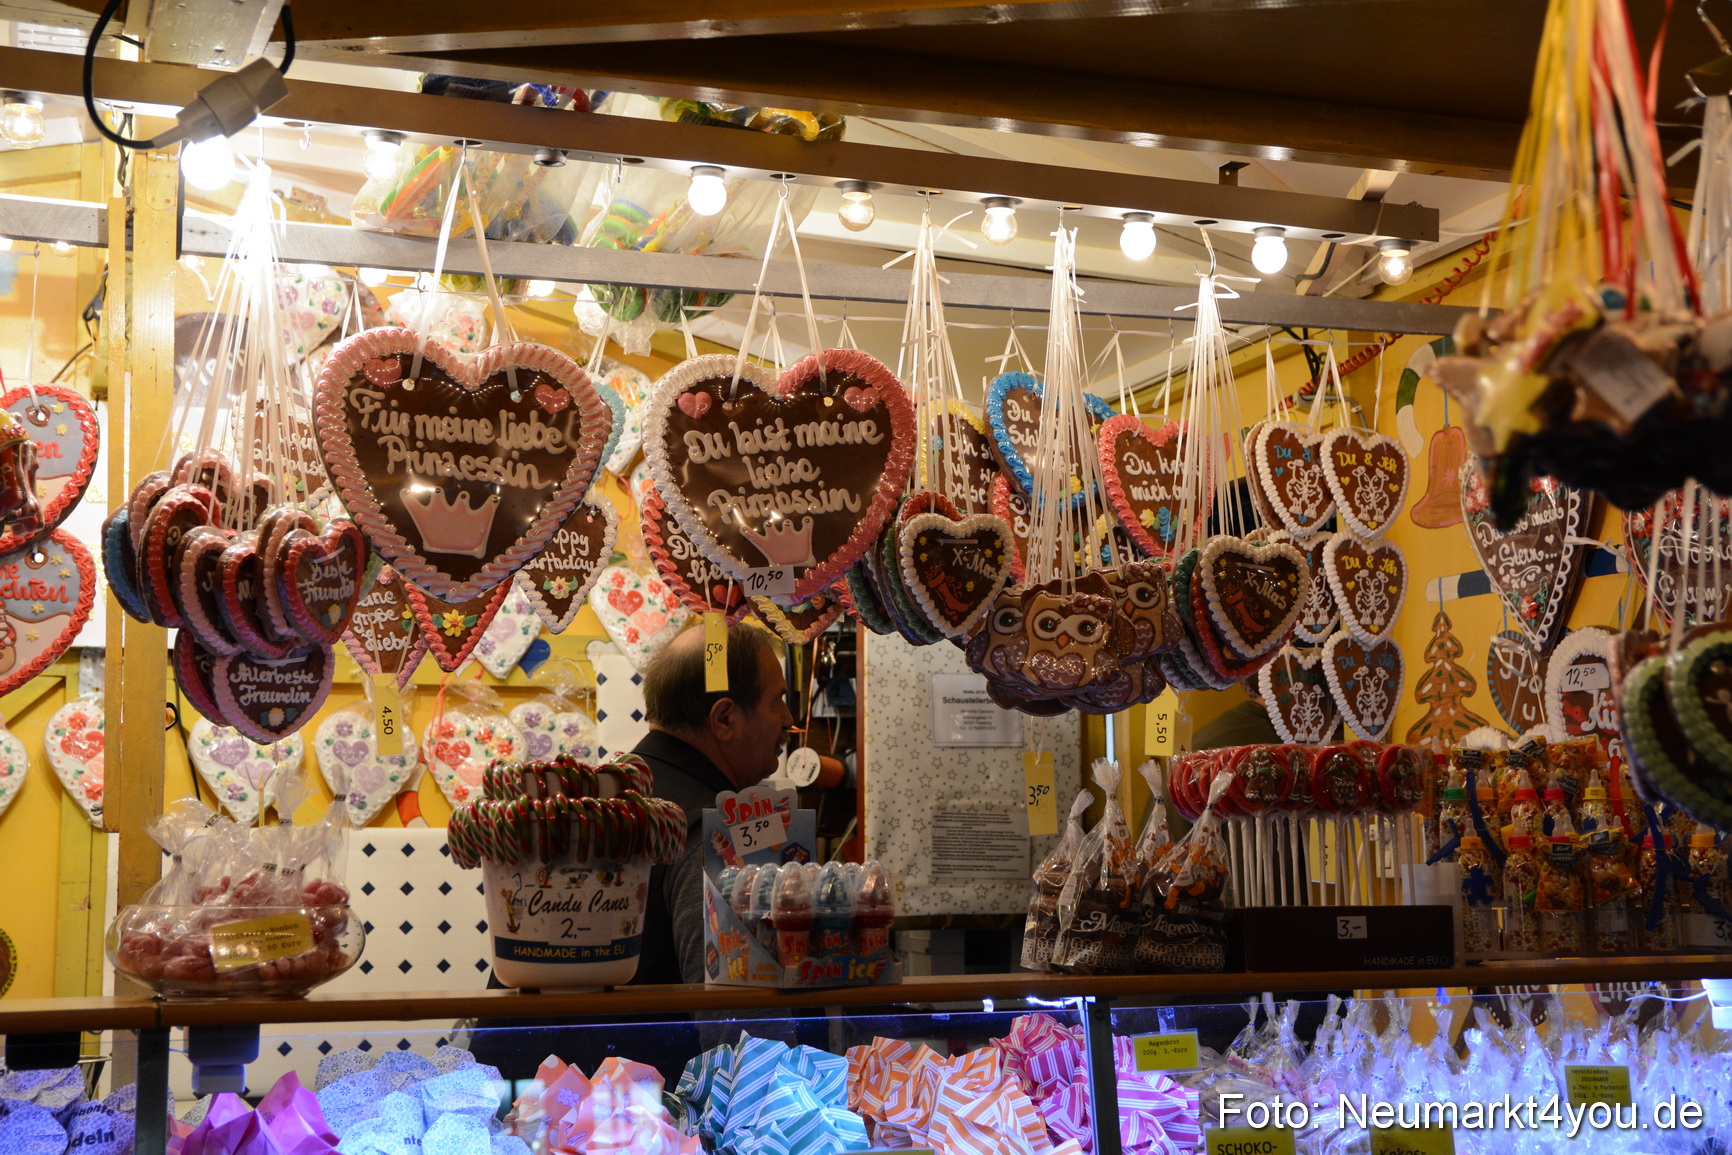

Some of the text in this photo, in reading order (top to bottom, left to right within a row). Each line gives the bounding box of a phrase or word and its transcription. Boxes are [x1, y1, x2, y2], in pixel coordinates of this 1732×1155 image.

[349, 389, 566, 454] Für meine liebe
[1007, 399, 1033, 423] Du
[684, 414, 884, 463] Du bist meine
[377, 436, 551, 489] Prinzessin
[1123, 452, 1156, 475] Du
[1274, 444, 1292, 459] Du
[1337, 451, 1358, 466] Du
[1364, 453, 1374, 467] &
[742, 456, 820, 489] liebe
[1129, 478, 1171, 502] mich
[552, 528, 589, 556] appy
[312, 556, 352, 581] Beste
[952, 547, 999, 580] X-Mas
[1342, 555, 1362, 570] Du
[1366, 555, 1375, 569] &
[1244, 571, 1287, 610] X-Mas
[240, 685, 311, 706] Freundin
[382, 706, 393, 735] 4,50
[1156, 714, 1167, 743] 5,50
[588, 889, 629, 913] Canes
[1071, 911, 1140, 937] Magen
[514, 944, 625, 958] HANDMADE in the EU
[1364, 956, 1439, 966] HANDMADE in EU
[1148, 1039, 1180, 1047] Magenbrot
[71, 1128, 115, 1148] deln
[1217, 1141, 1278, 1155] SCHOKO-
